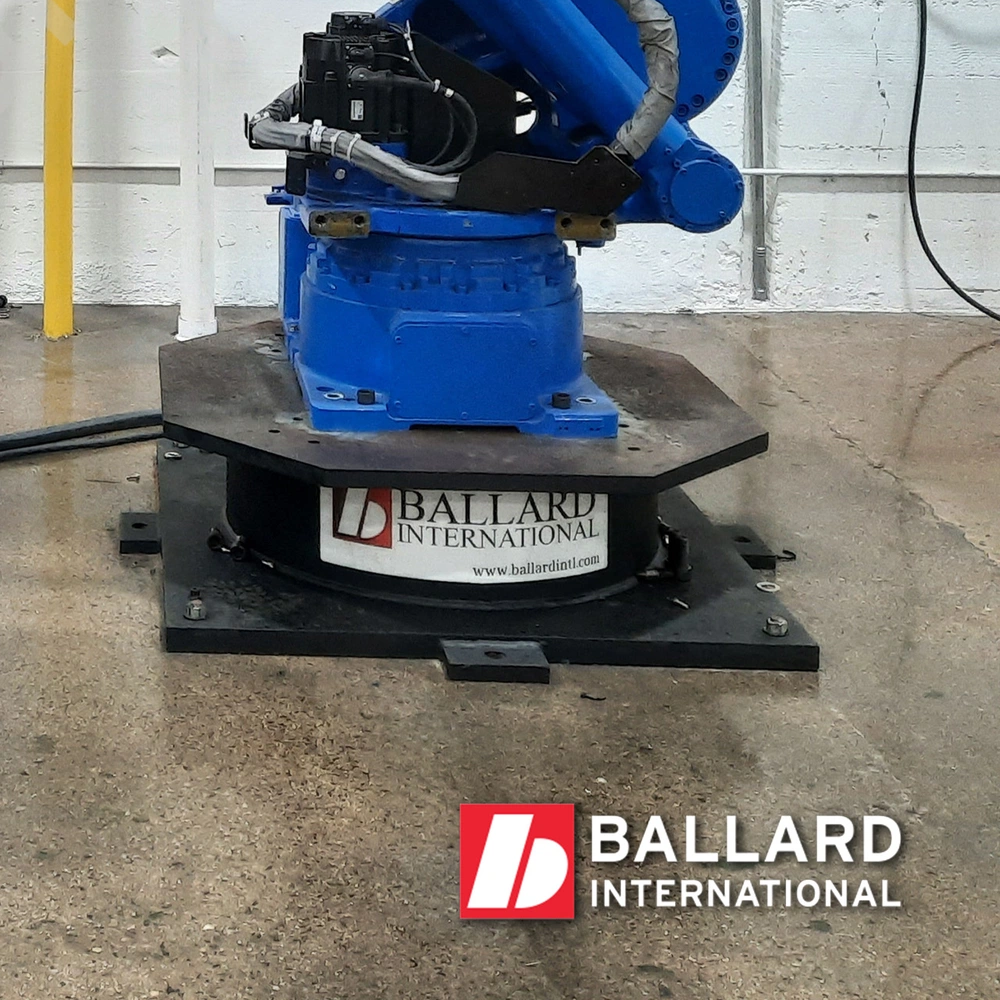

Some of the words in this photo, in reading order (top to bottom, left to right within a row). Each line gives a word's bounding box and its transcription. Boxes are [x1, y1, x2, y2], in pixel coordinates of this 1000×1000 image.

[399, 490, 596, 526] BALLARD
[397, 518, 600, 550] INTERNATIONAL
[472, 553, 601, 578] www.ballardintl.com
